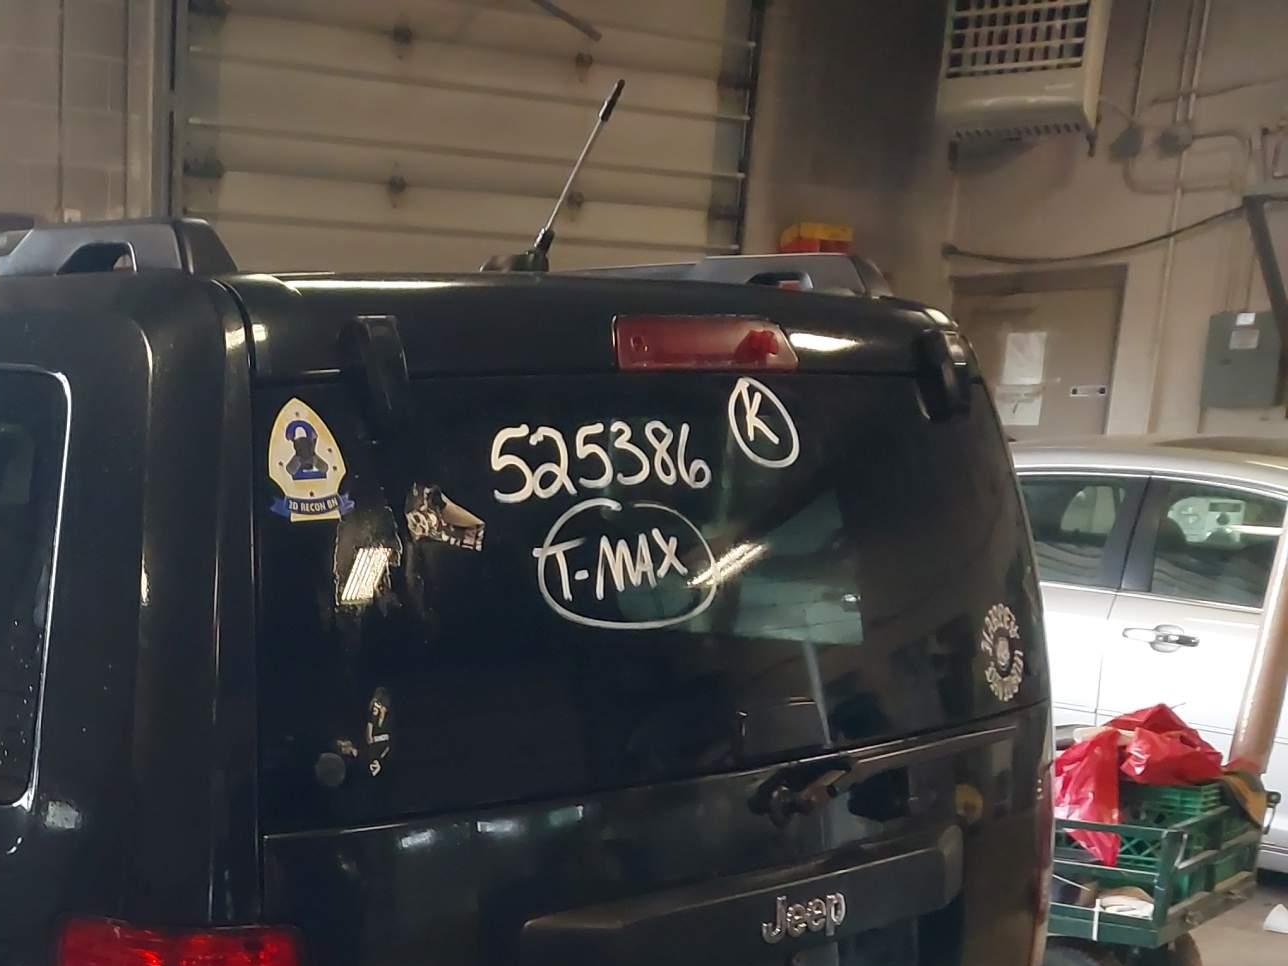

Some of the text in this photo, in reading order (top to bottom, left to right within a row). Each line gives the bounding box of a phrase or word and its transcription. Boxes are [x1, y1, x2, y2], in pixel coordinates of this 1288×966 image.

[738, 379, 780, 445] K
[491, 421, 711, 503] 525386
[532, 527, 688, 602] T-MAX
[762, 893, 846, 944] Jeep
